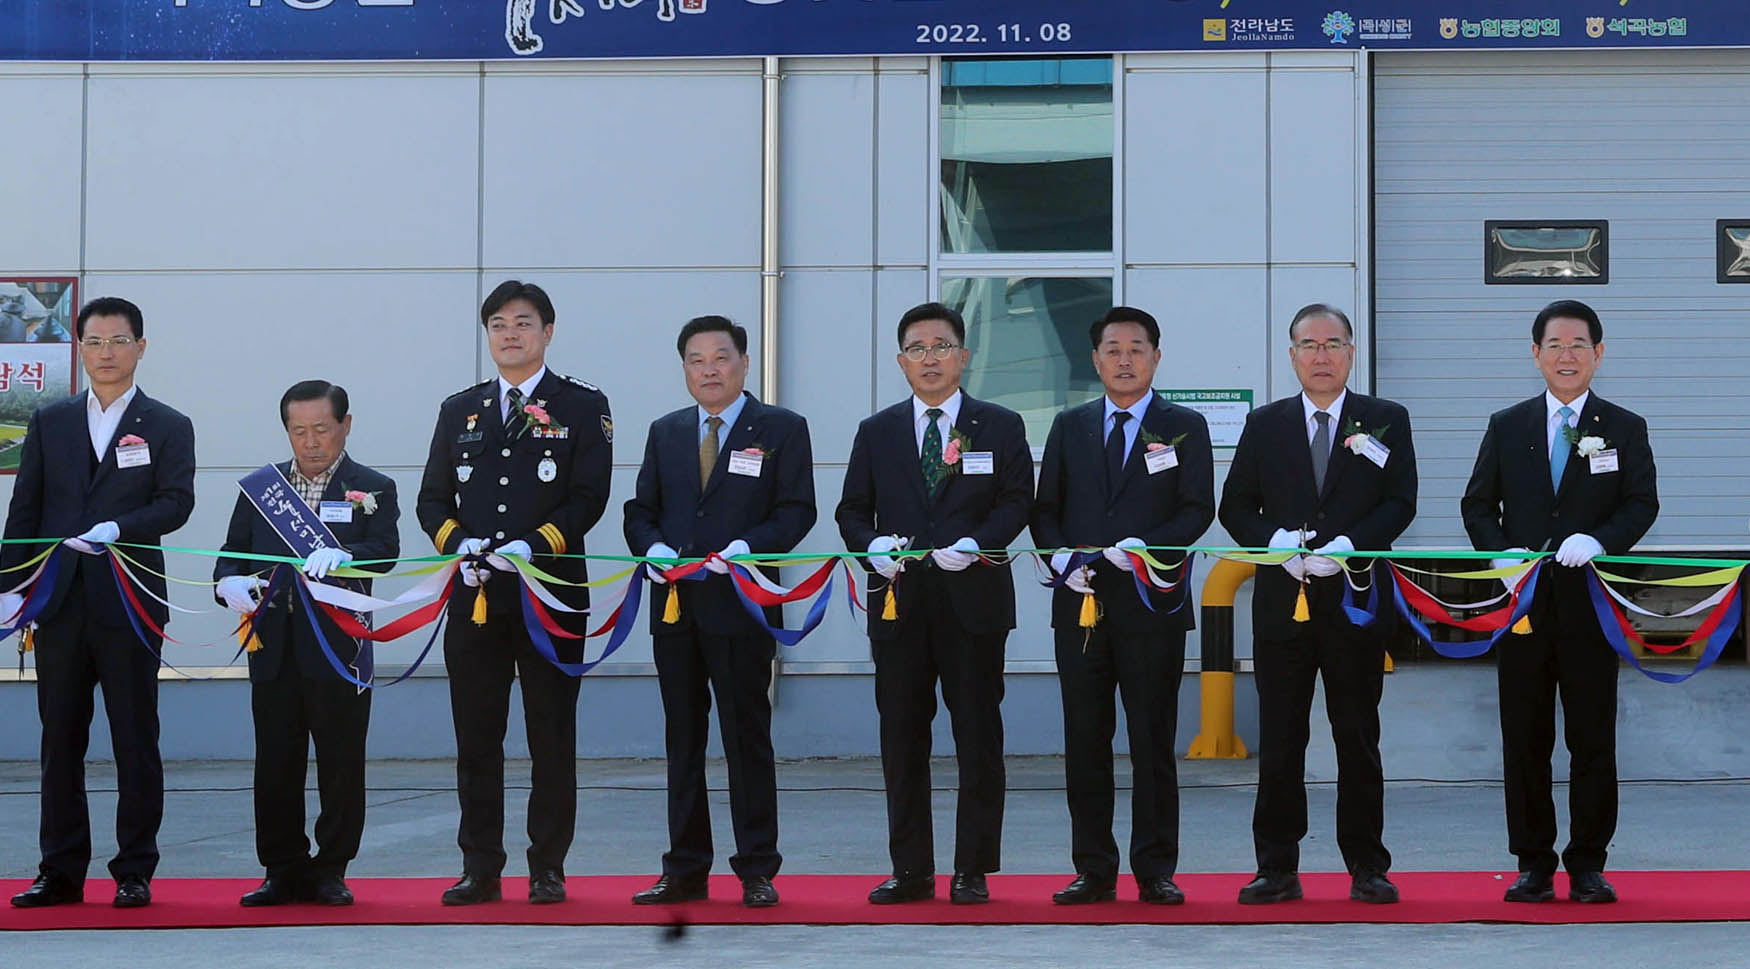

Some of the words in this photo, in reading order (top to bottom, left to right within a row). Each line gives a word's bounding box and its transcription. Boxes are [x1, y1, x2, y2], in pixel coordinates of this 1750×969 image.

[916, 23, 987, 44] 2022.
[1039, 23, 1073, 43] 08
[1230, 18, 1295, 33] 전라남도
[1607, 17, 1688, 37] 석곡농협
[1231, 33, 1295, 42] JeollaNamdo
